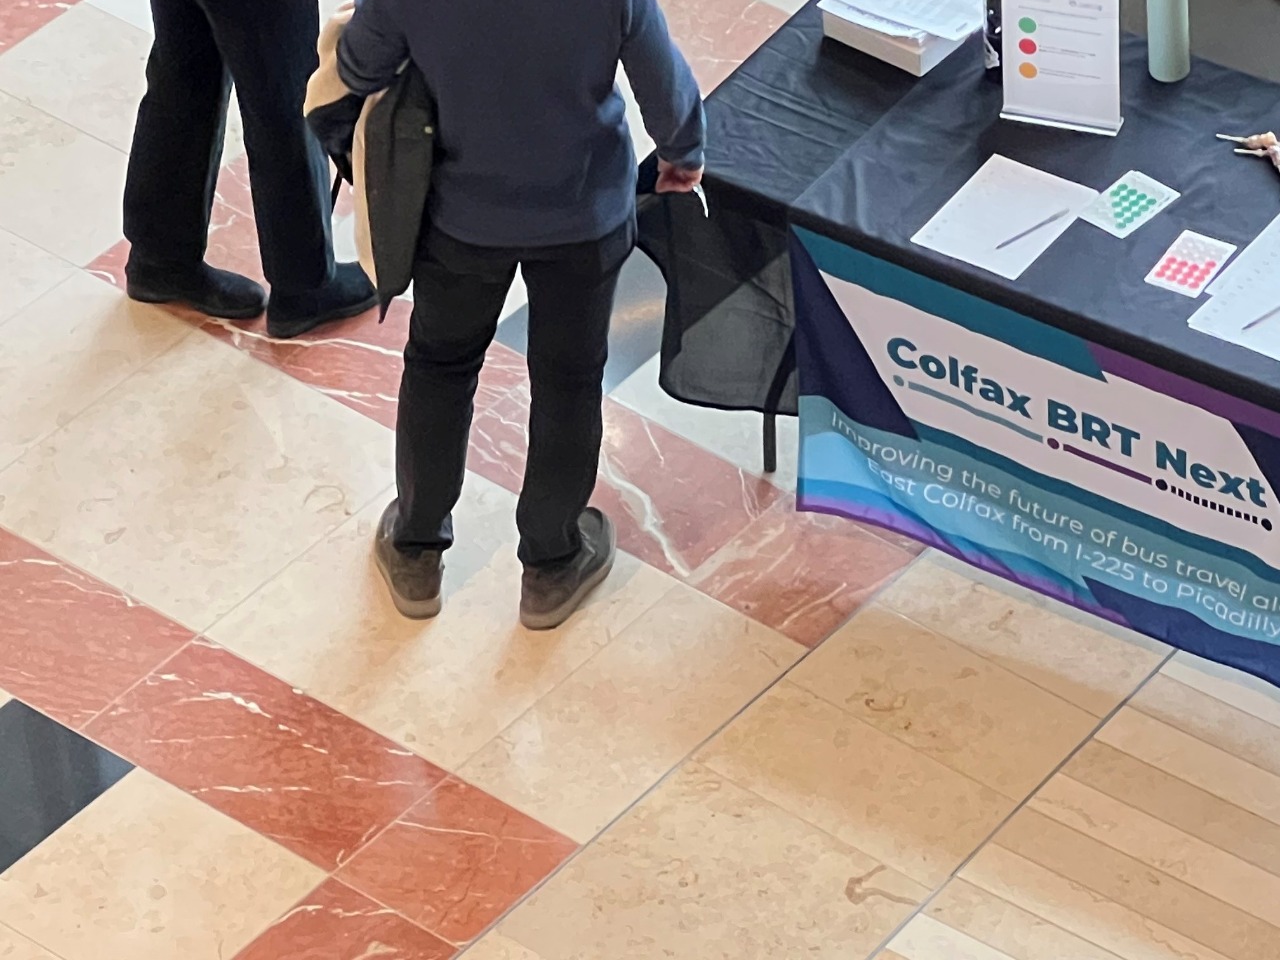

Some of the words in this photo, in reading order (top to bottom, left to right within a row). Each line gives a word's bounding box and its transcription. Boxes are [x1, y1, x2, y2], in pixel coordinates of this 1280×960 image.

[831, 411, 954, 483] Improving
[962, 469, 1001, 499] the
[1008, 490, 1084, 534] future
[1090, 528, 1118, 549] of
[1122, 536, 1168, 569] bus
[1176, 558, 1247, 601] travel
[887, 337, 1032, 420] Colfax
[1047, 399, 1141, 458] BRT
[1155, 440, 1268, 508] Next
[867, 457, 916, 496] East
[923, 483, 1006, 524] Colfax
[1012, 515, 1069, 553] from
[1076, 544, 1135, 581] I-225
[1143, 571, 1168, 593] to
